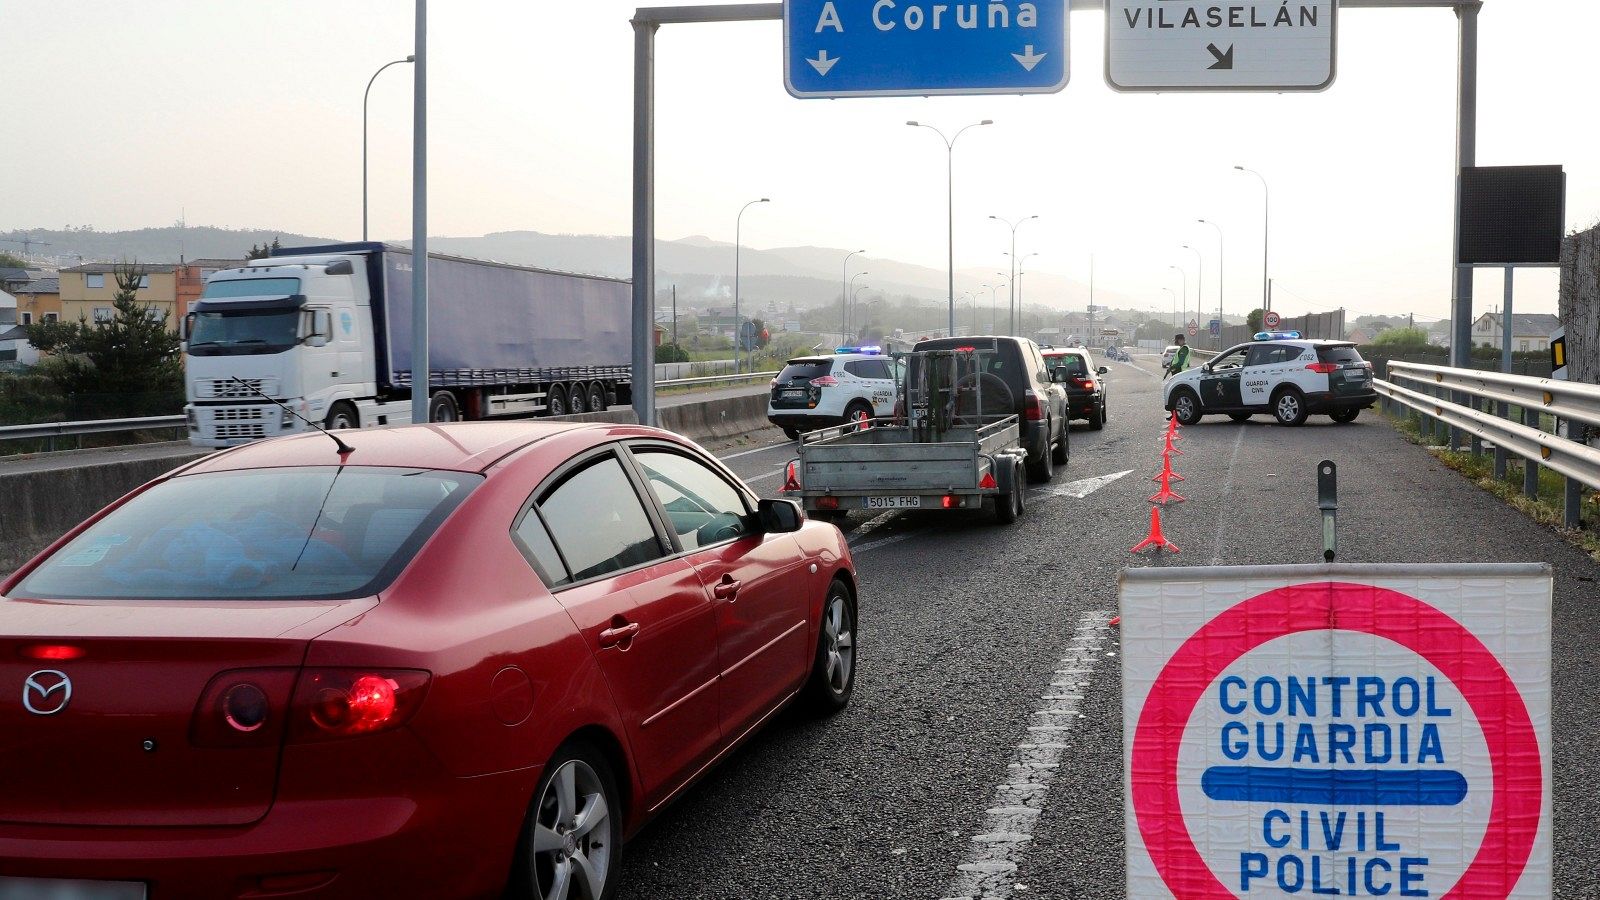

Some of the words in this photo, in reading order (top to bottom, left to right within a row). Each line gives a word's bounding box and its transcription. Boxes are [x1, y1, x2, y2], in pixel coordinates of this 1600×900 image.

[815, 2, 844, 33] A
[872, 0, 1037, 31] Coruña
[1124, 1, 1318, 29] VILASELÁN
[870, 496, 895, 507] 5015
[899, 496, 918, 507] FHG
[1219, 675, 1452, 718] CONTROL
[1221, 721, 1445, 764] GUARDIA
[1263, 809, 1401, 852] CIVIL
[1240, 852, 1429, 898] POLICE
